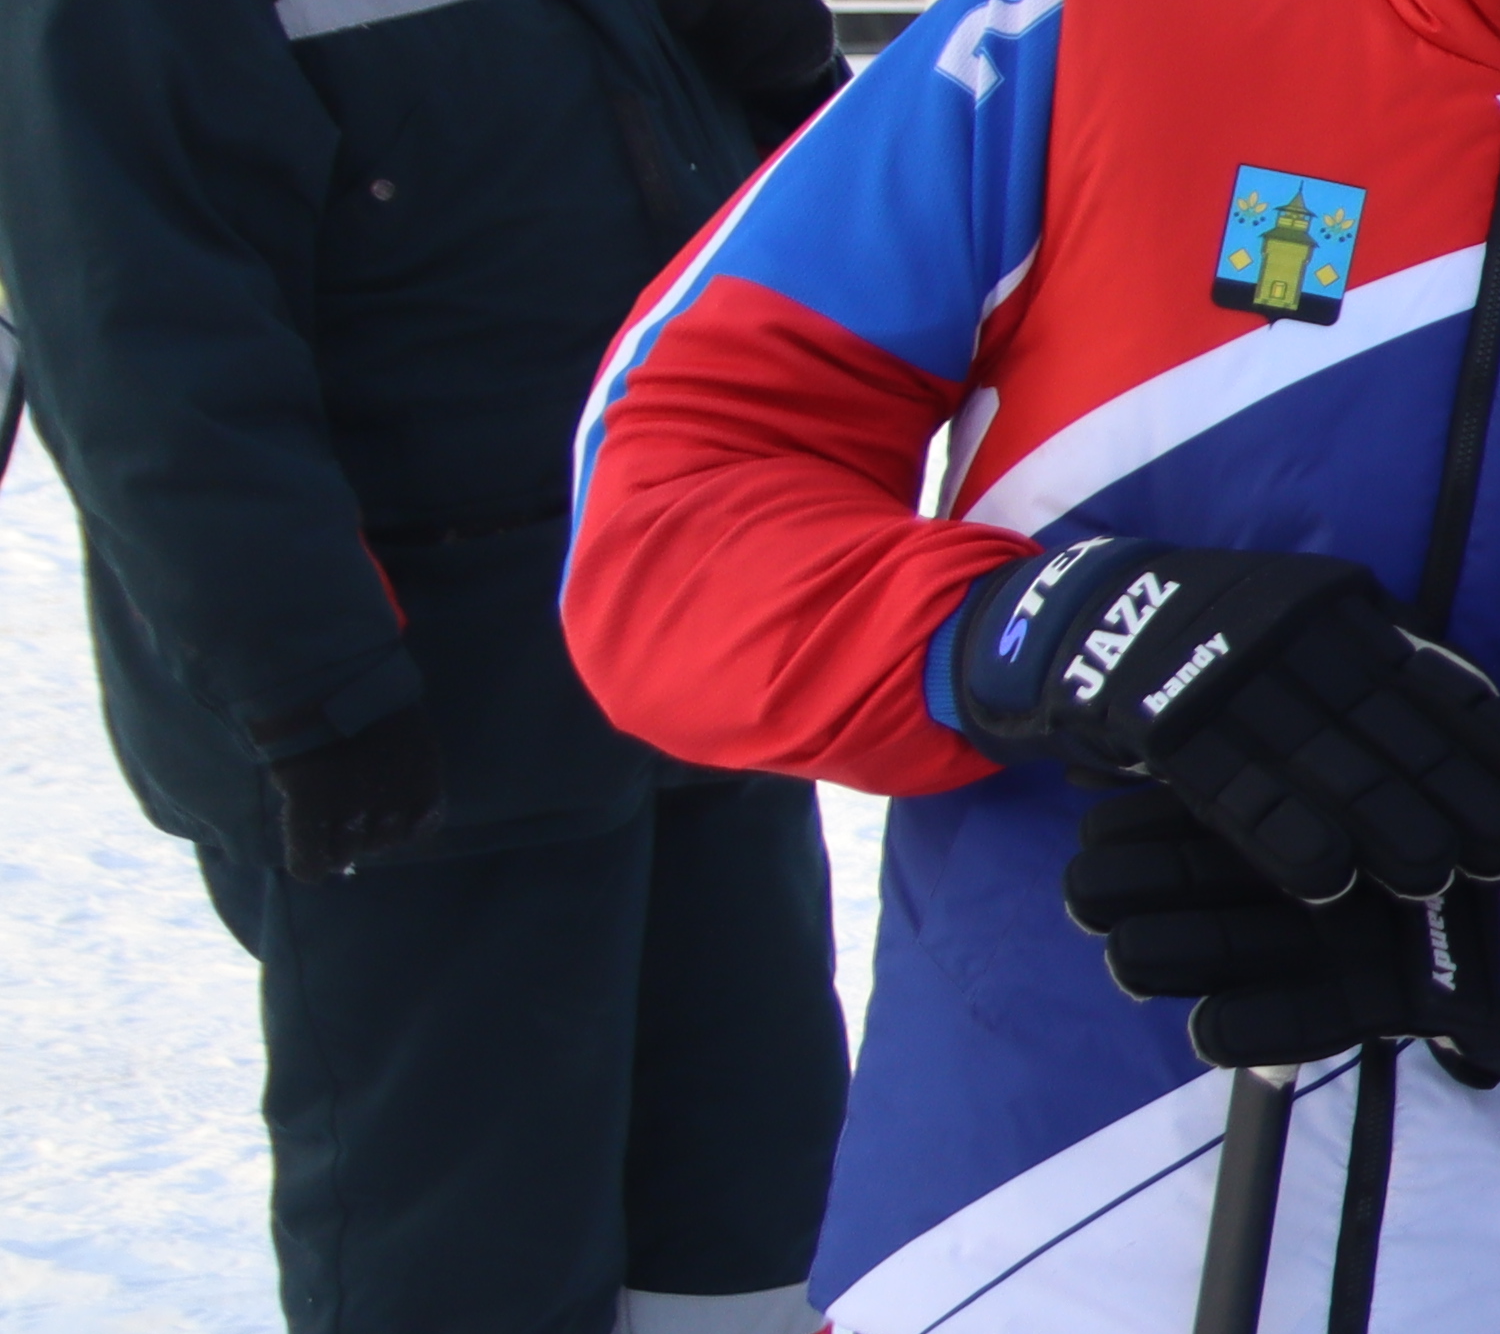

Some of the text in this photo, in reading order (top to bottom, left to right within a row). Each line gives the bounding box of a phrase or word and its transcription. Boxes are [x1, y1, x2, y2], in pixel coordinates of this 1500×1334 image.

[998, 535, 1115, 663] STEX
[1063, 571, 1181, 700] JAZZ
[1142, 632, 1230, 714] bandy
